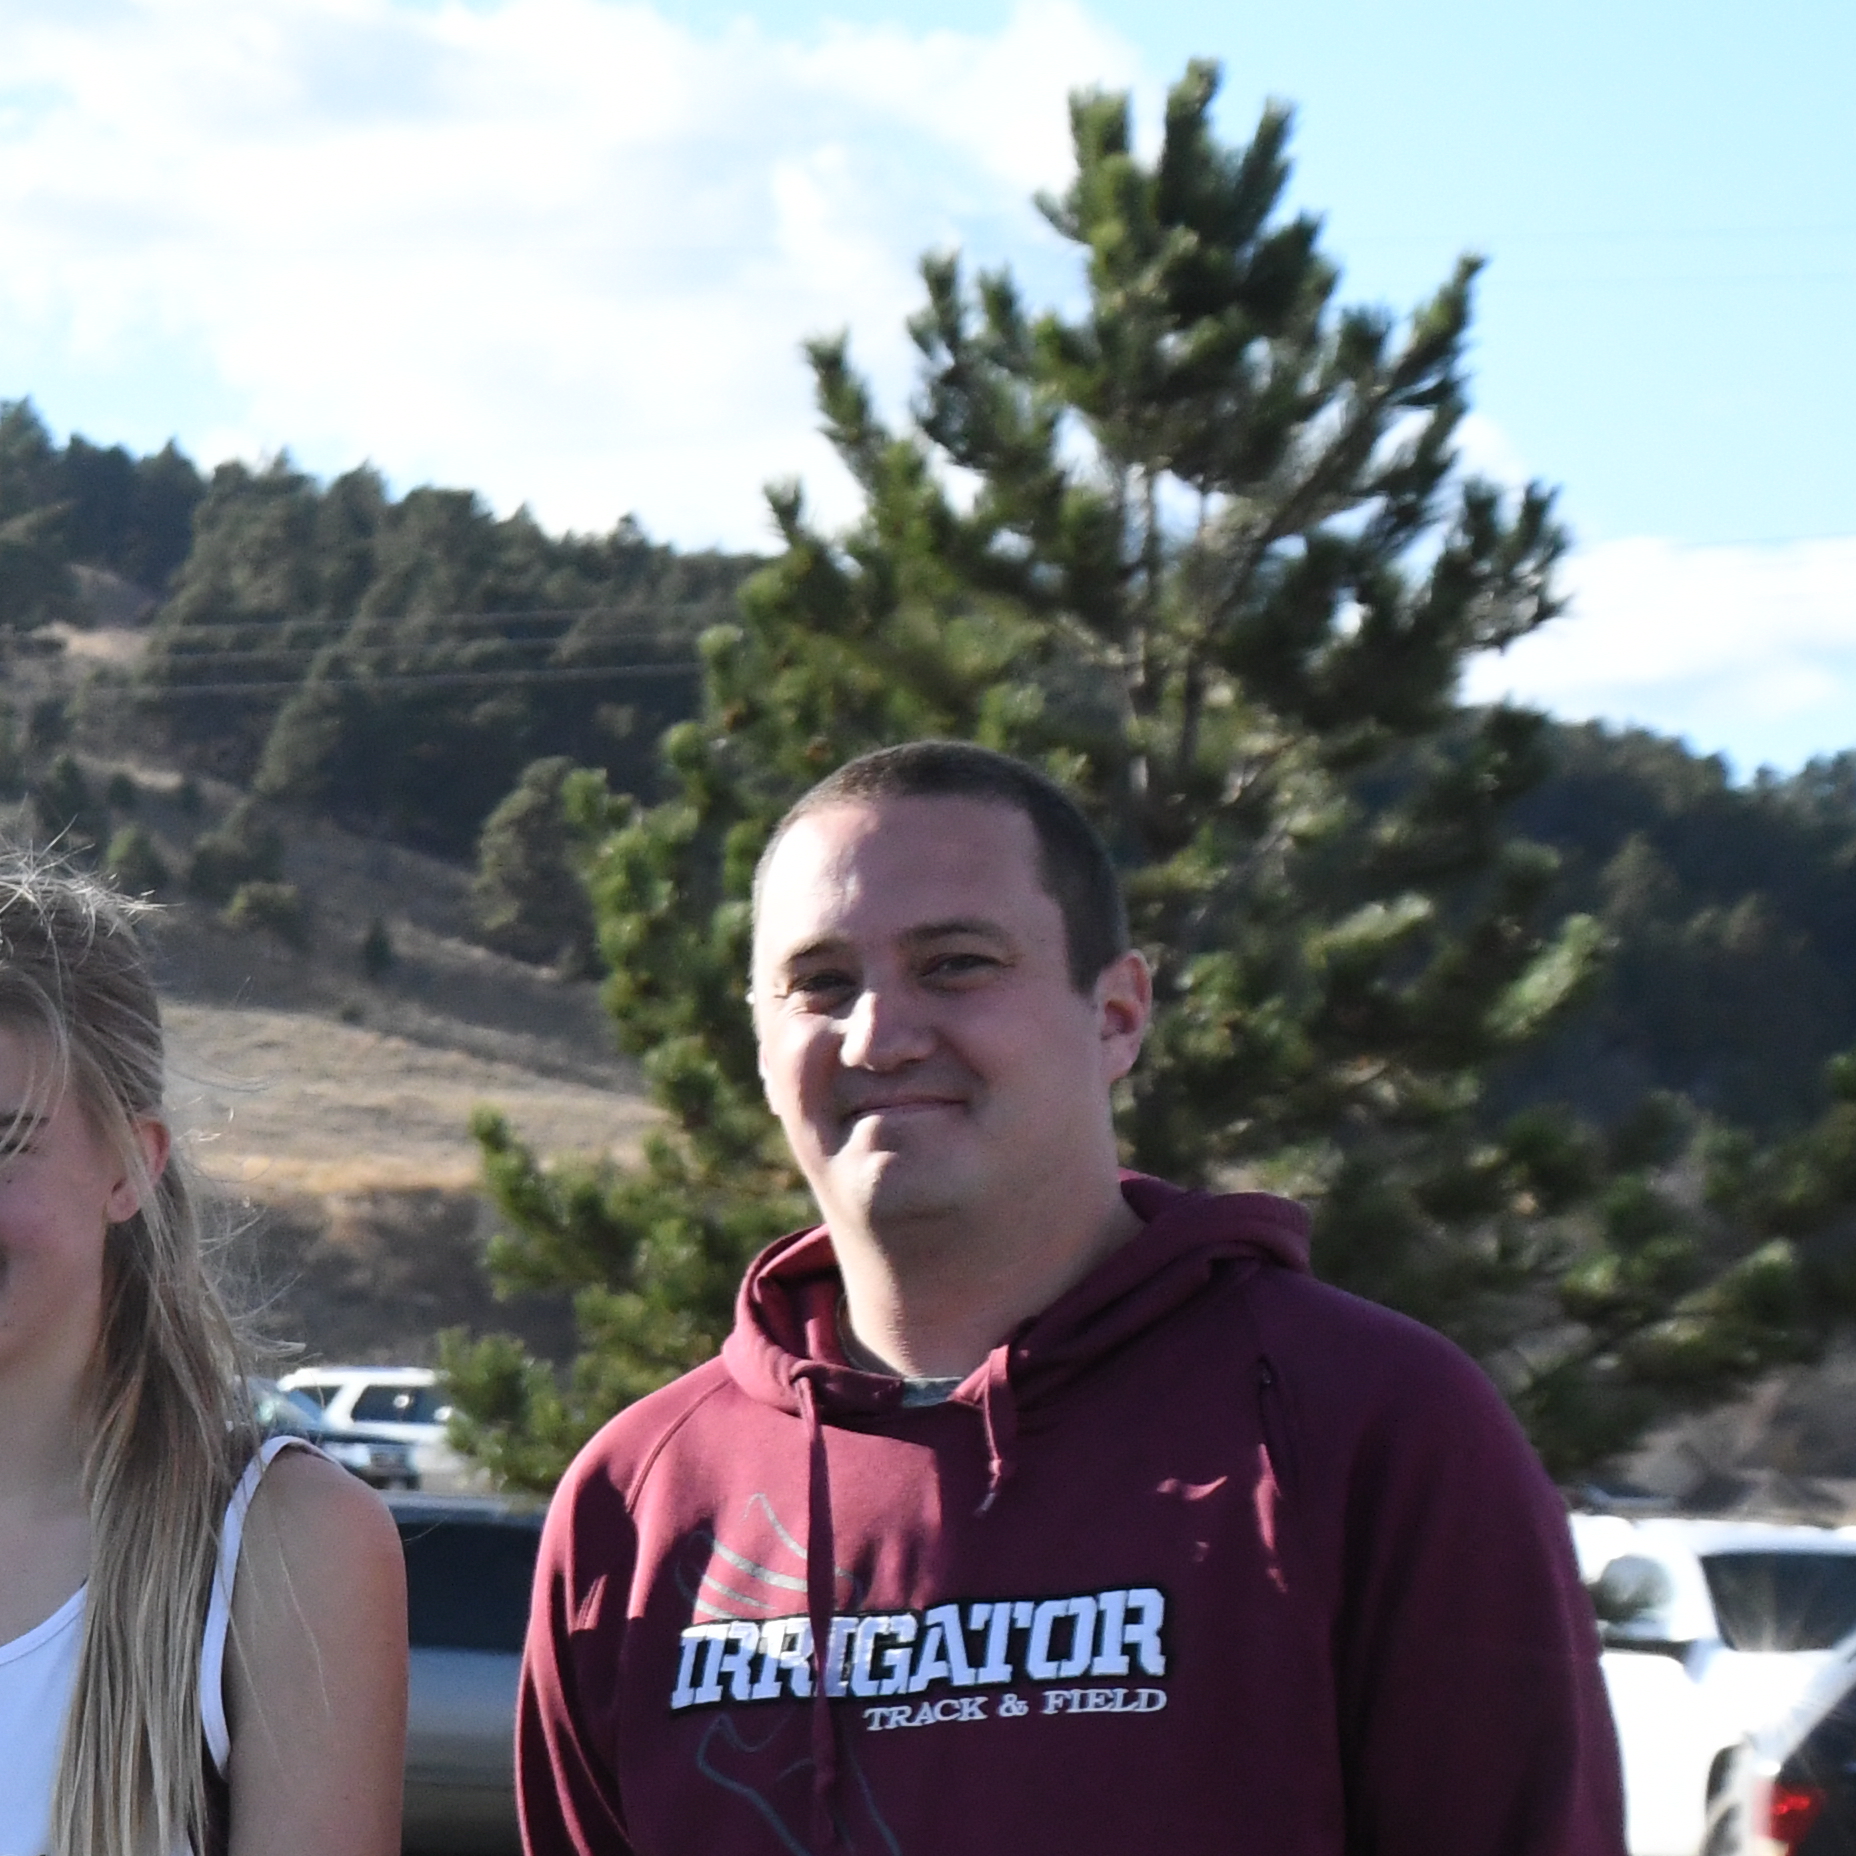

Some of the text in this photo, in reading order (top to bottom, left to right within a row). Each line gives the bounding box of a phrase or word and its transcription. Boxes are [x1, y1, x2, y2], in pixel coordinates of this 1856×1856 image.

[671, 1587, 1166, 1711] IRRIGATOR
[863, 1688, 1167, 1732] TRACK & FIELD
